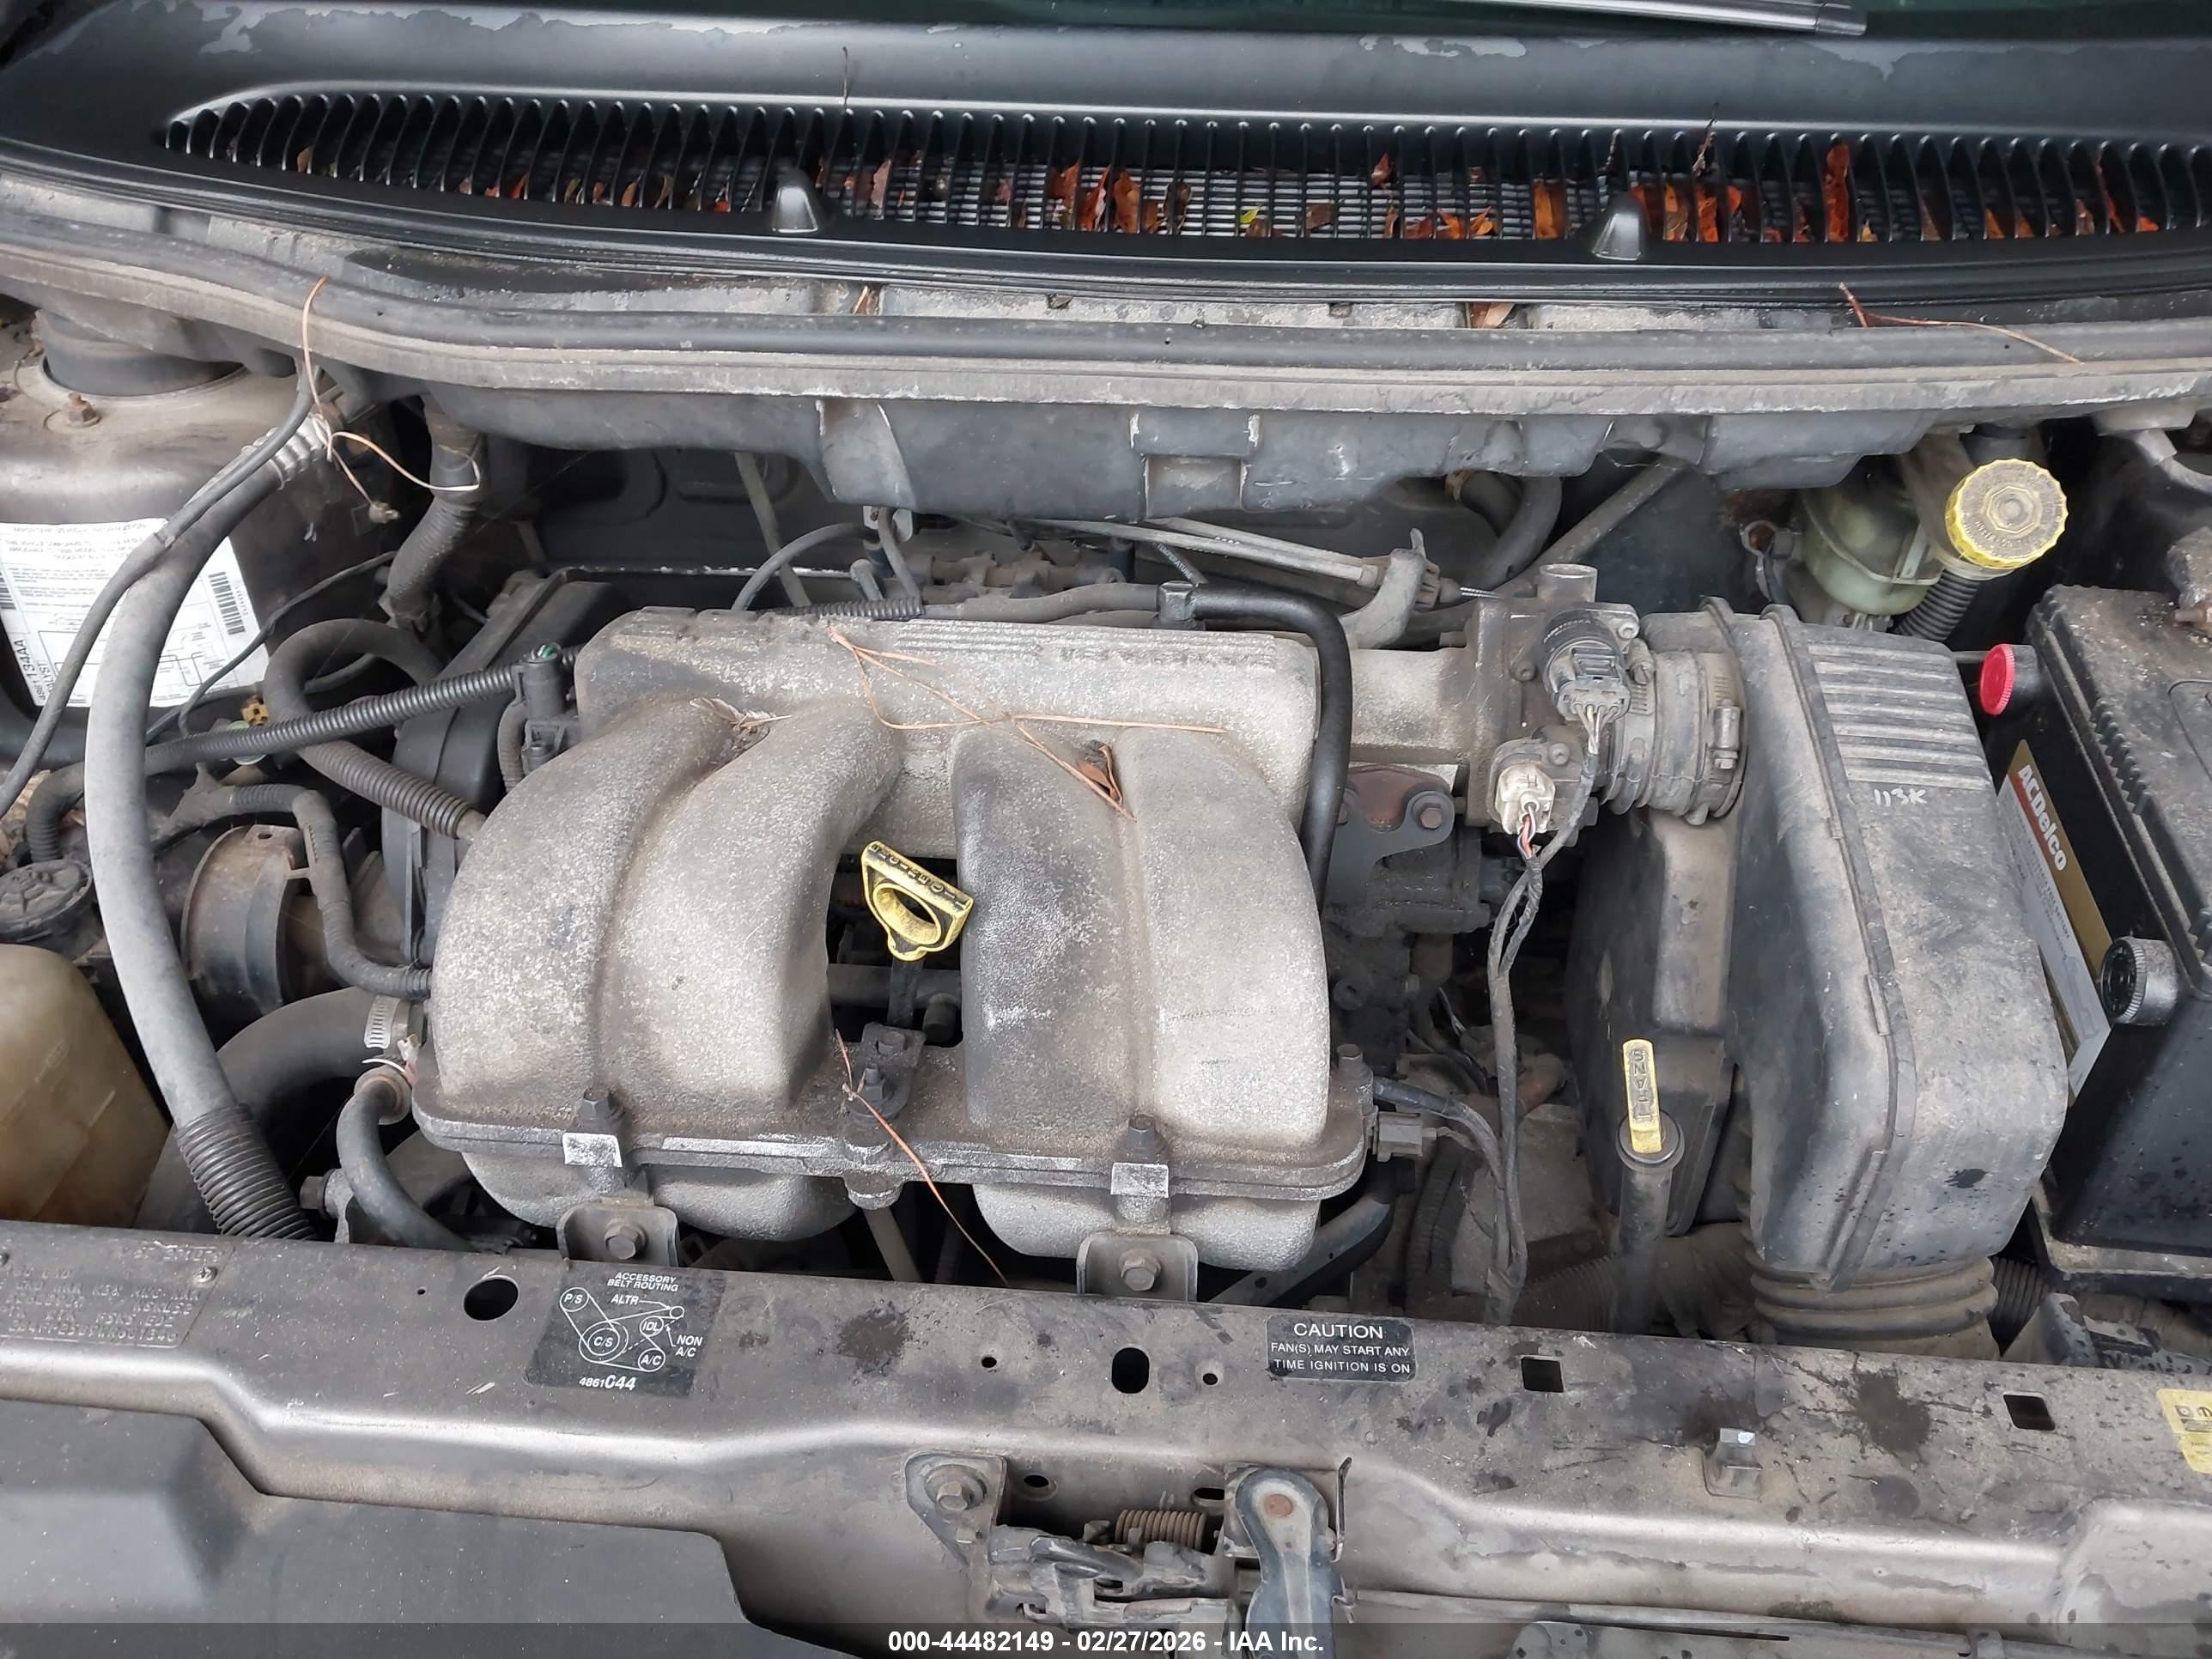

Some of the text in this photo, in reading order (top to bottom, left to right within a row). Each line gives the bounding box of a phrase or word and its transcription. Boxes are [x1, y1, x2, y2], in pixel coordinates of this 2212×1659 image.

[2018, 765, 2067, 871] ACDelco
[616, 1272, 676, 1283] ACCESSORY
[607, 1279, 678, 1292] BELT ROUTING
[564, 1294, 583, 1304] P/S
[611, 1293, 639, 1306] ALTR
[643, 1320, 659, 1331] IDL
[1293, 1322, 1383, 1340] CAUTION
[593, 1337, 613, 1347] C/S
[677, 1334, 702, 1346] NON
[675, 1346, 696, 1358] A/C
[1271, 1342, 1410, 1357] FAN(S) MAY START ANY
[641, 1355, 661, 1366] A/C
[1273, 1358, 1410, 1373] TIME IGNITION IS ON
